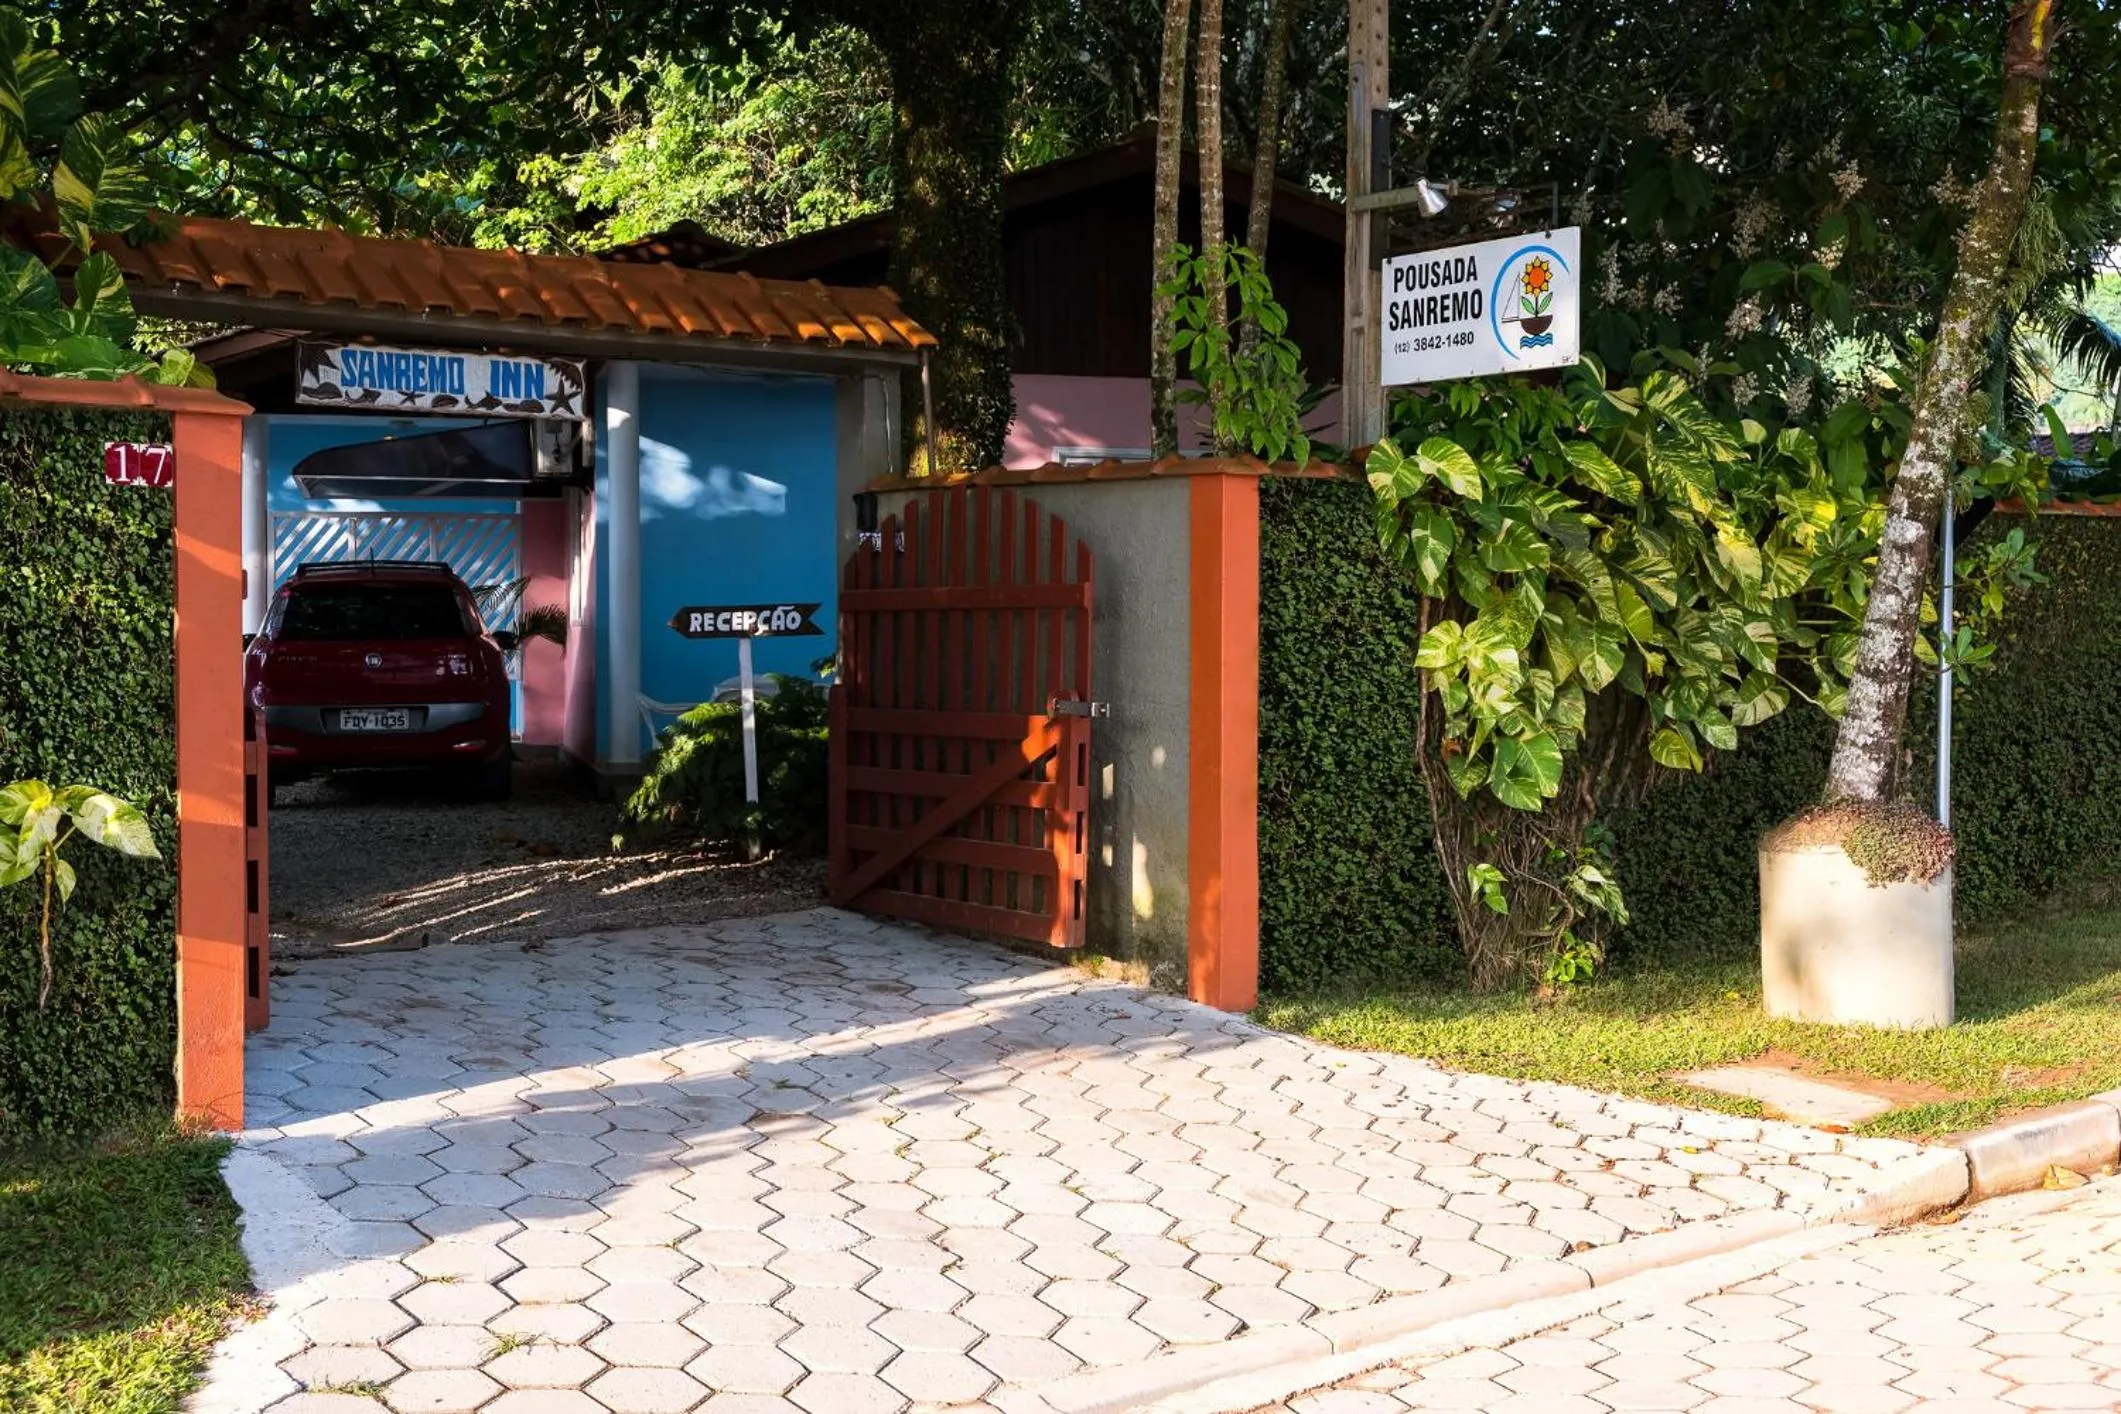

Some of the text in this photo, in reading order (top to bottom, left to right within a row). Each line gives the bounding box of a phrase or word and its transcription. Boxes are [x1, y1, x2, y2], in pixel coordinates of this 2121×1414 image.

[1393, 255, 1478, 293] POUSADA
[1389, 288, 1483, 331] SANREMO
[1394, 331, 1475, 355] (12) 3842-1480
[340, 348, 545, 400] SANREMO INN
[114, 445, 167, 484] 17
[689, 605, 802, 636] RECEPÇÃO
